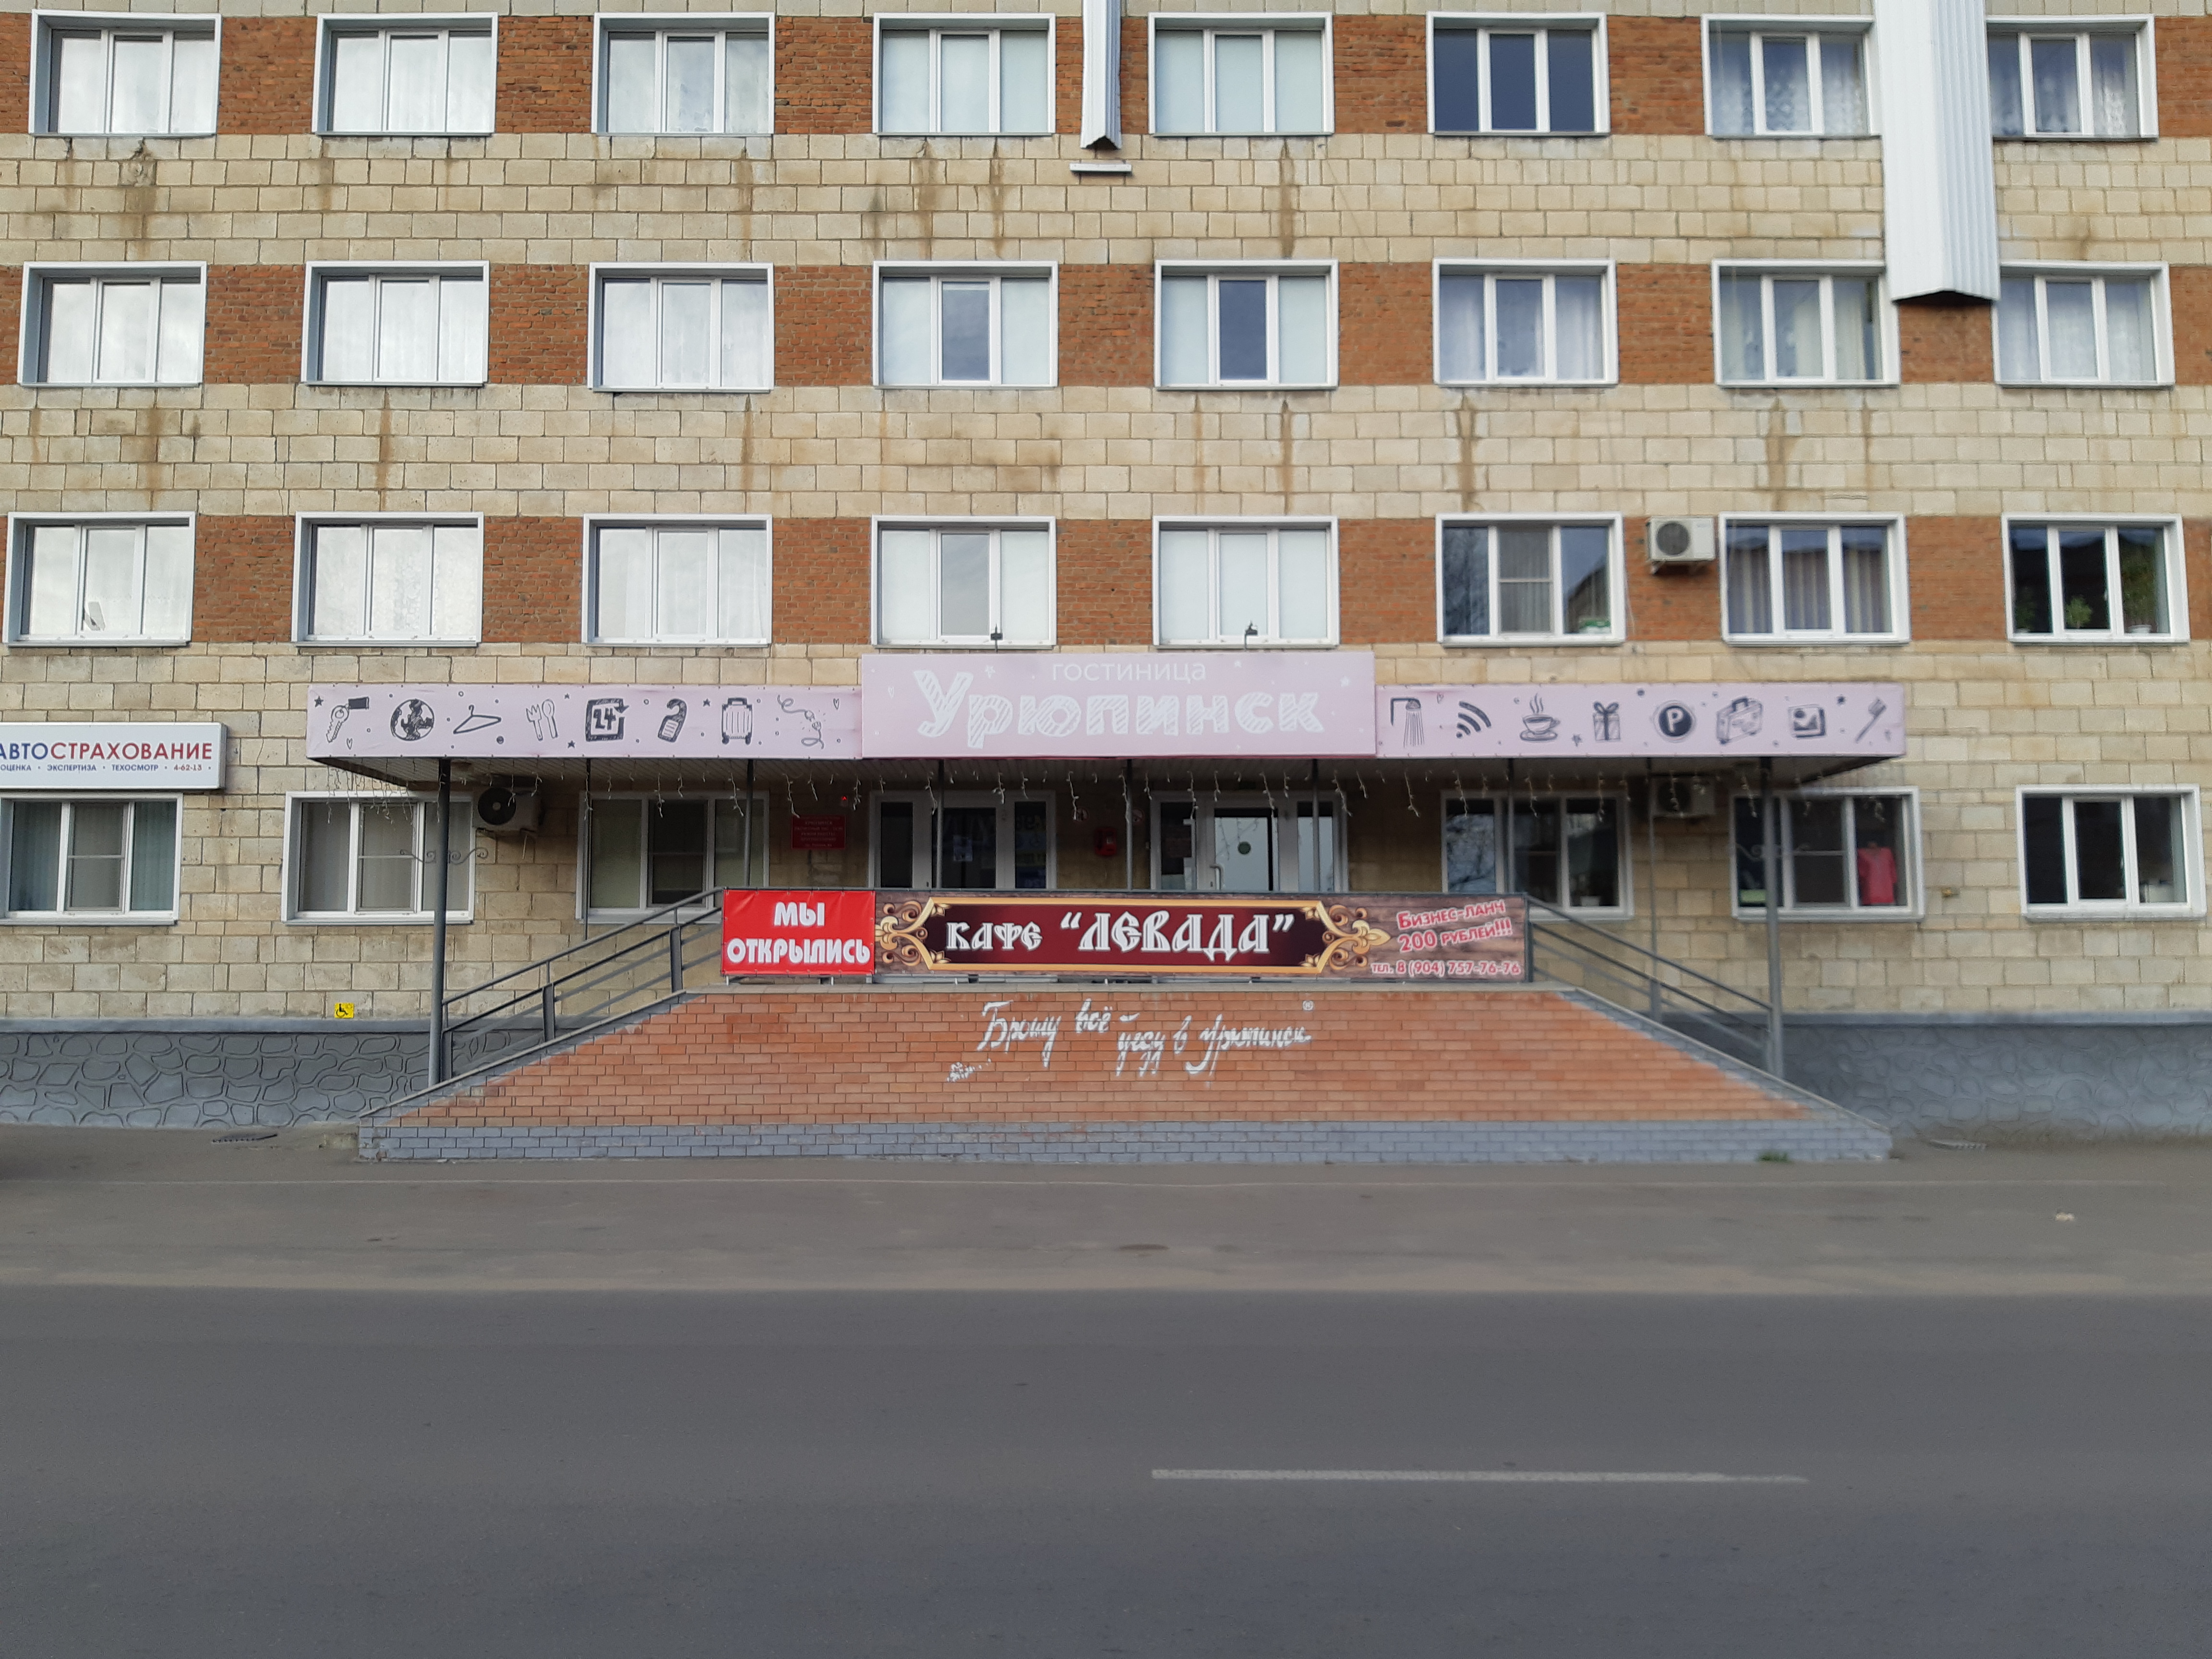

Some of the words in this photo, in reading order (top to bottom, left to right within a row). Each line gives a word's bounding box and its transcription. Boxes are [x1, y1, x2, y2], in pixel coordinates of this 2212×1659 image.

[593, 708, 616, 730] 24
[914, 669, 1324, 749] Урюпинск
[0, 764, 31, 772] ОЦЕНКА
[47, 764, 96, 772] ЭКСПЕРТИЗА
[774, 902, 825, 926] МЫ
[946, 921, 1043, 951] КАФЕ
[1398, 930, 1437, 952] 200
[727, 938, 870, 964] ОТКРЫЛИСЬ
[1396, 960, 1406, 974] 8
[1408, 960, 1445, 977] (904)
[1448, 960, 1521, 974] 757-76-76
[977, 1000, 1062, 1068] Брошу
[1075, 998, 1113, 1034] всё
[1173, 1015, 1192, 1054] в
